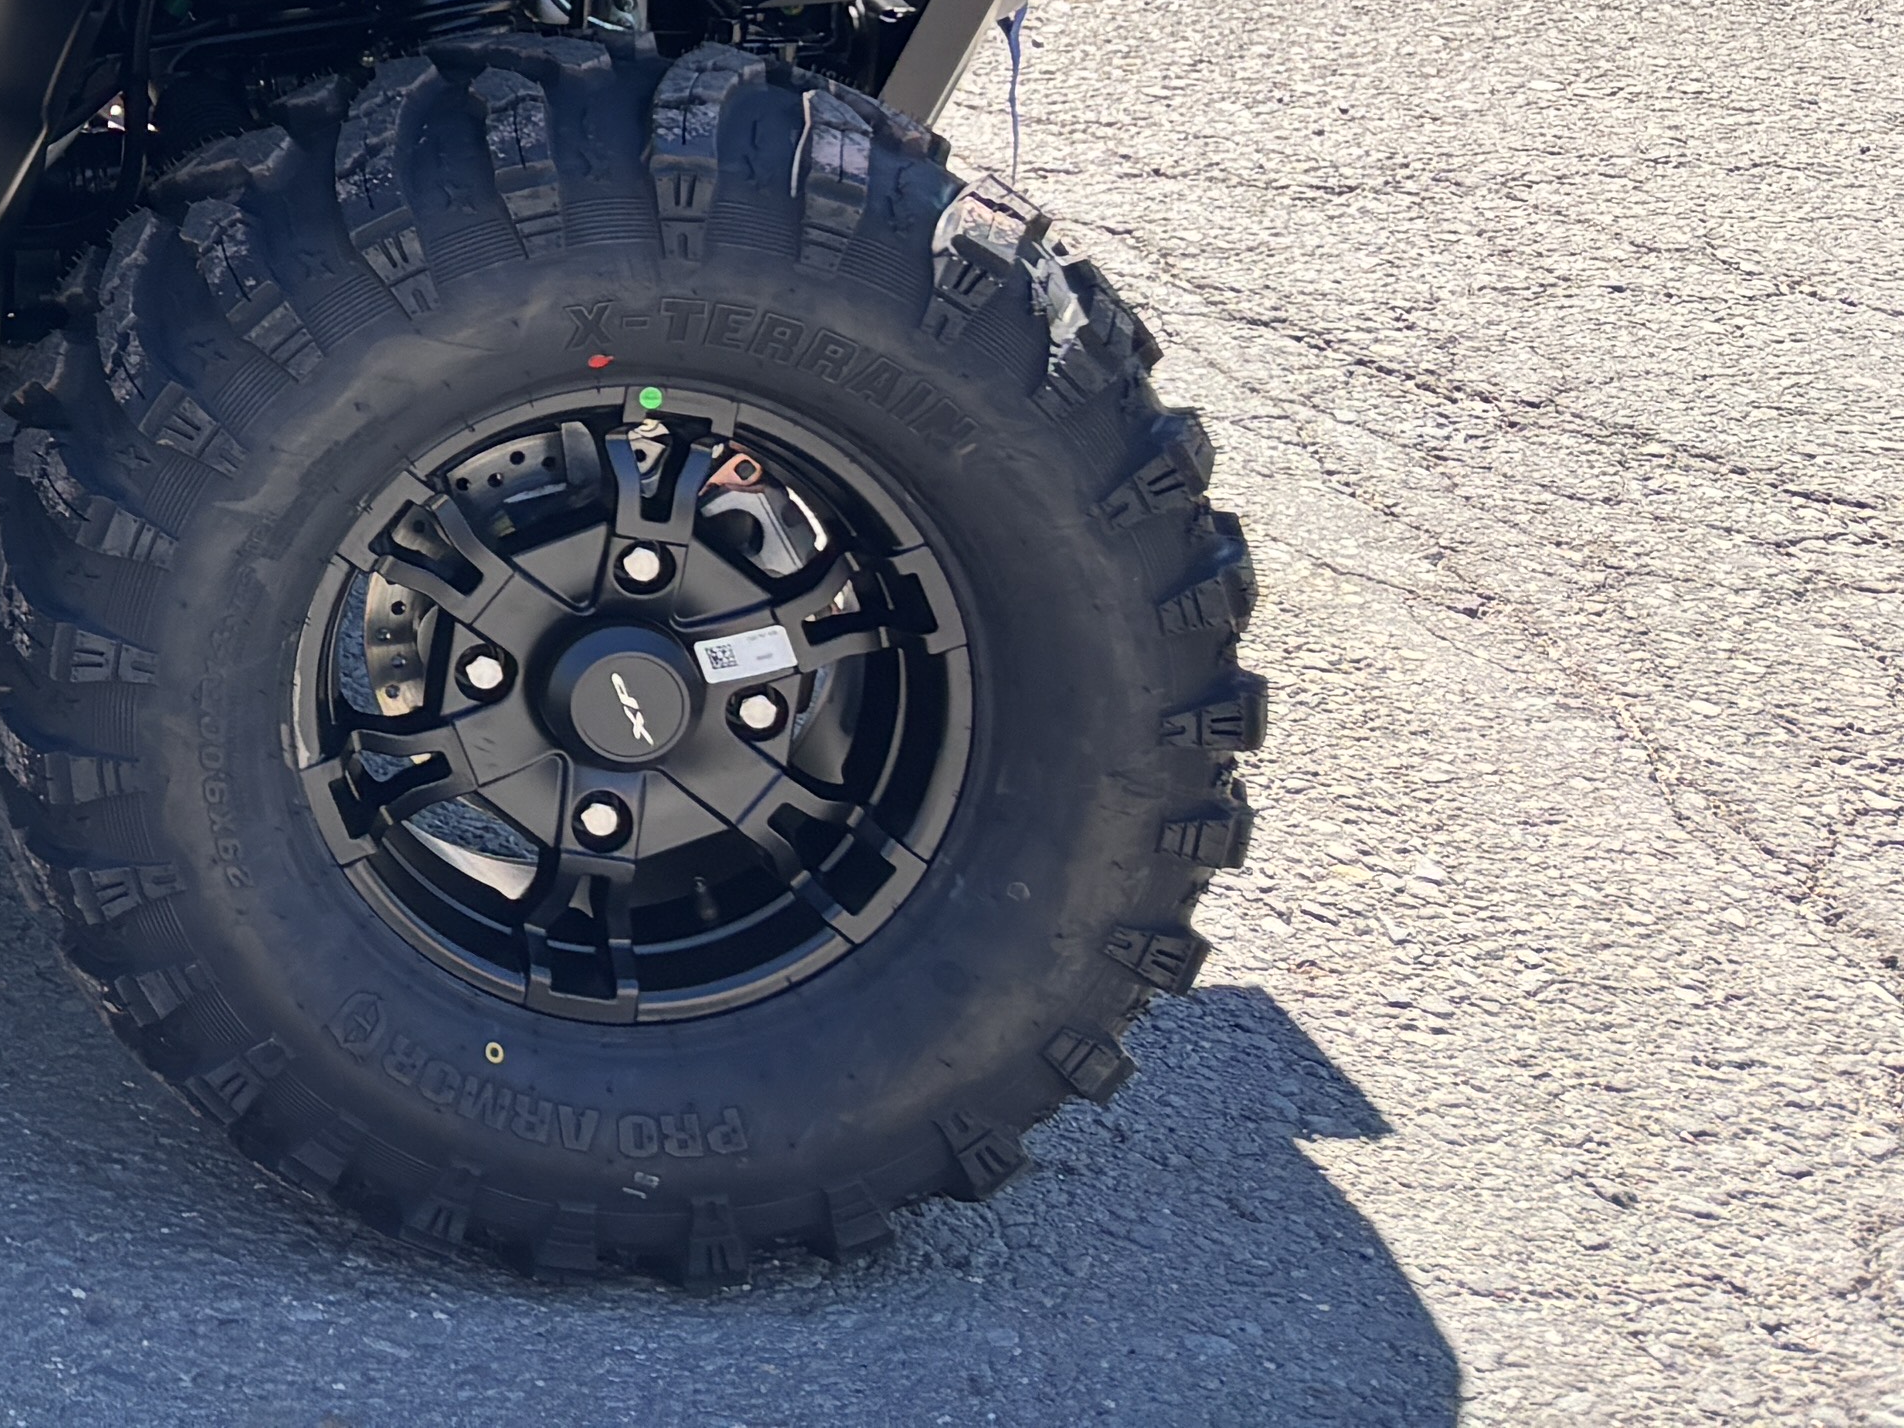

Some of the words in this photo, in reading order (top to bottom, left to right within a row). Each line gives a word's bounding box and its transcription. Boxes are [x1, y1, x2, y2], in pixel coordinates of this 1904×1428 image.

[563, 297, 982, 448] X-TERRAIN
[611, 672, 654, 746] XP
[382, 1036, 601, 1152] ARMOR
[617, 1107, 749, 1158] PRO
